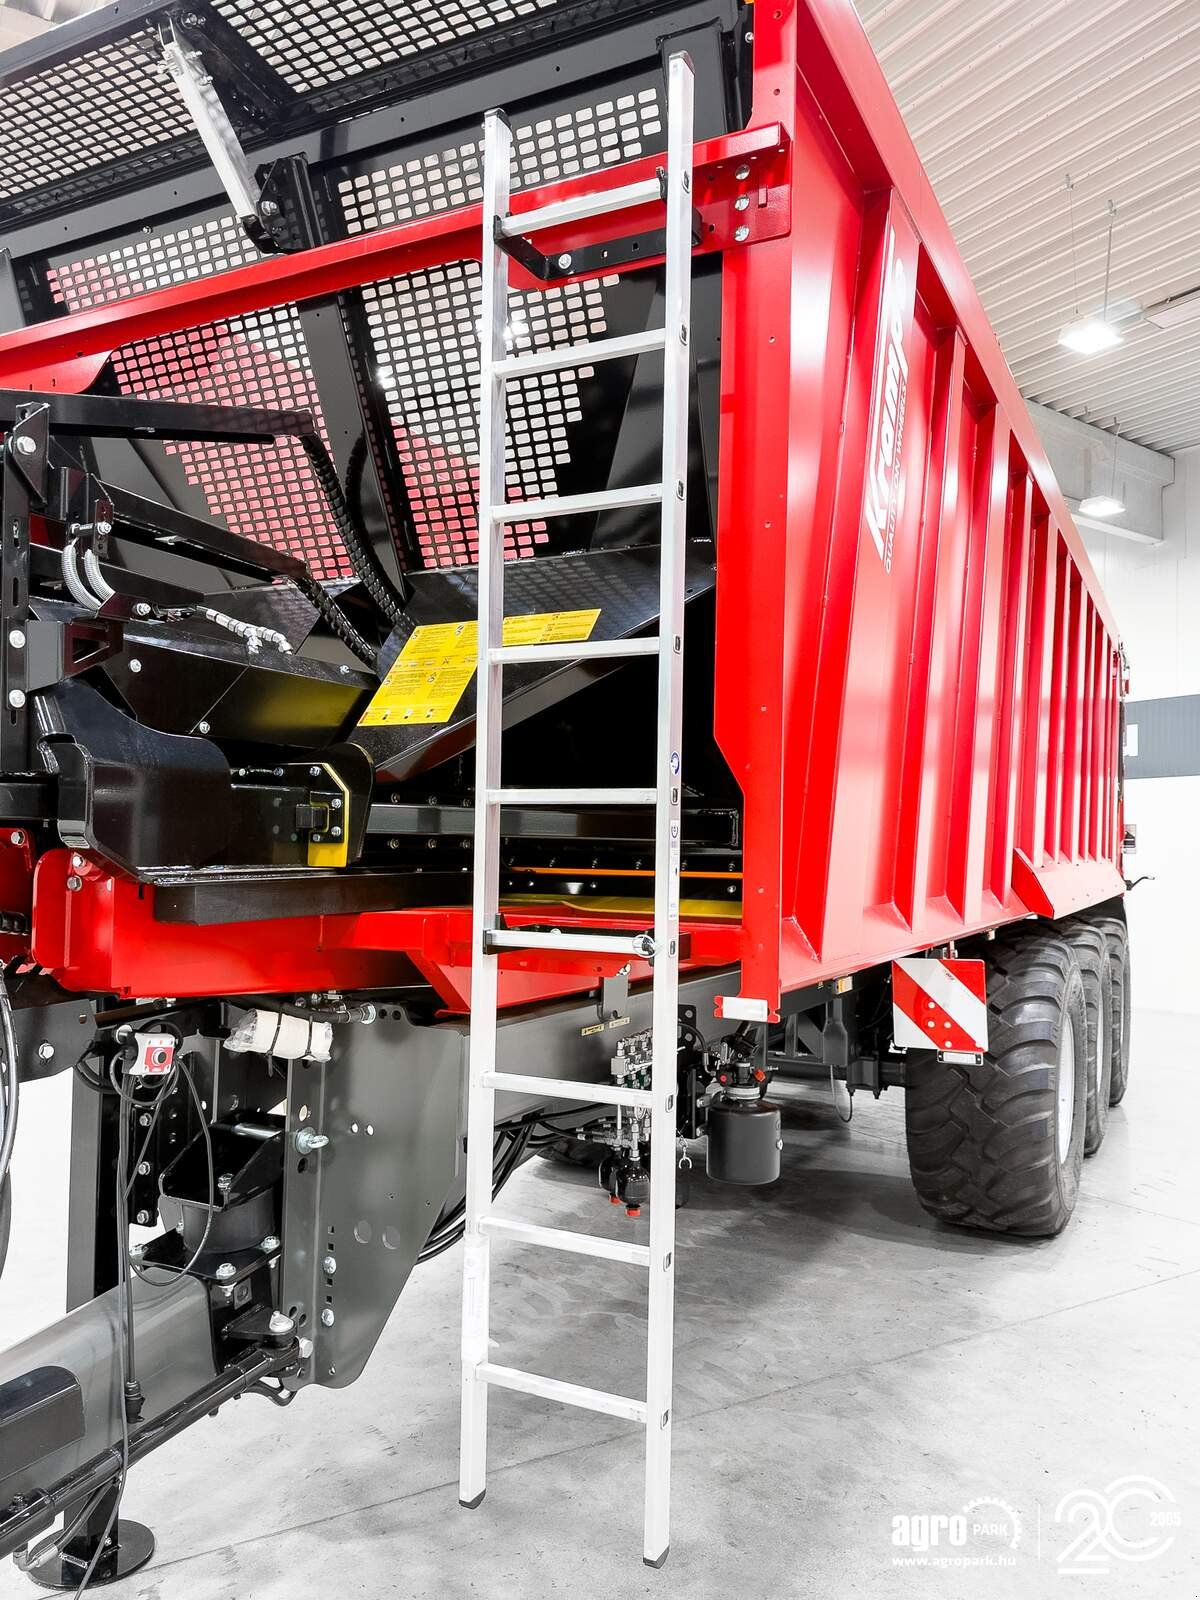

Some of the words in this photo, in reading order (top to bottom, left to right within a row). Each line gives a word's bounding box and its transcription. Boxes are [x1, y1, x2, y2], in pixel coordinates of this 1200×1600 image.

[896, 381, 907, 453] WHEELS
[894, 459, 902, 489] ON
[884, 495, 897, 574] QUALITY
